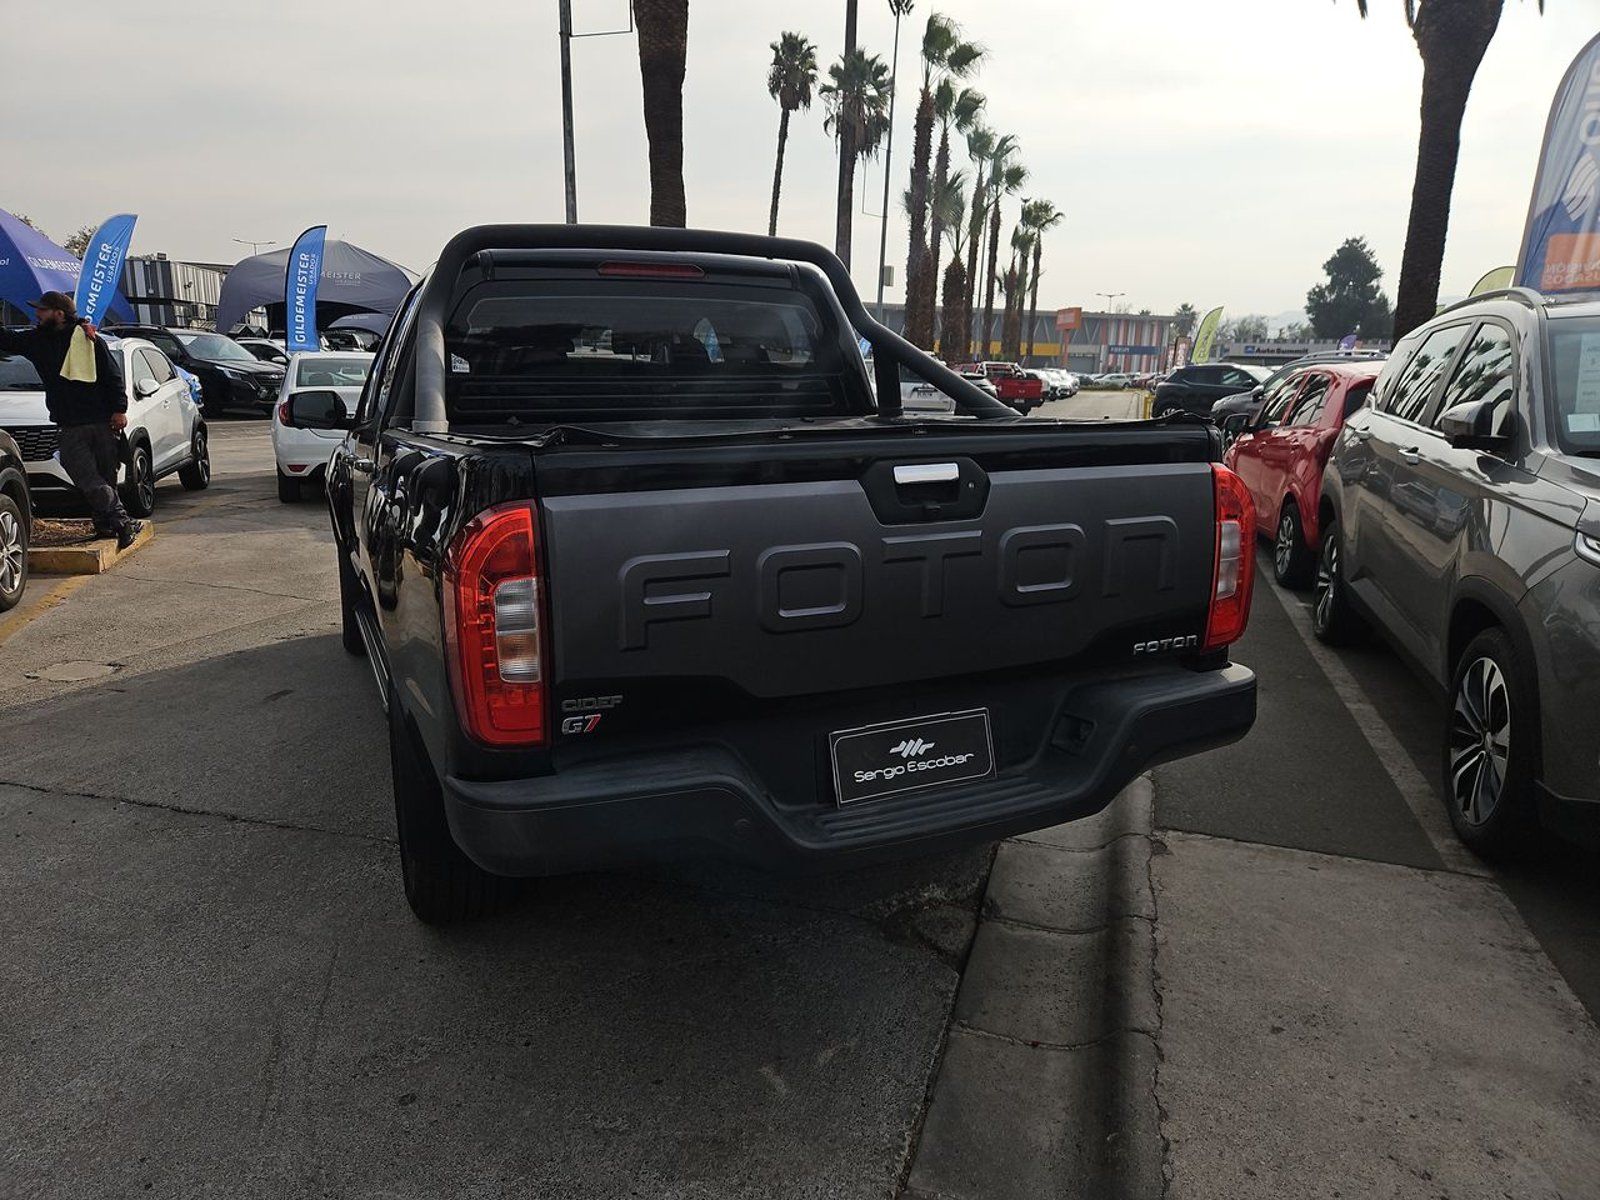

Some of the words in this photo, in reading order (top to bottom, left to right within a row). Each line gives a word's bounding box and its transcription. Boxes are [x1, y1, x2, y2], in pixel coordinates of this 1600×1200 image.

[294, 252, 310, 343] GILDEMEISTER
[618, 514, 1180, 652] FOTON
[1133, 634, 1198, 656] FOTON
[561, 694, 623, 712] CIDEF
[561, 713, 602, 736] G7
[906, 753, 975, 772] Escobar
